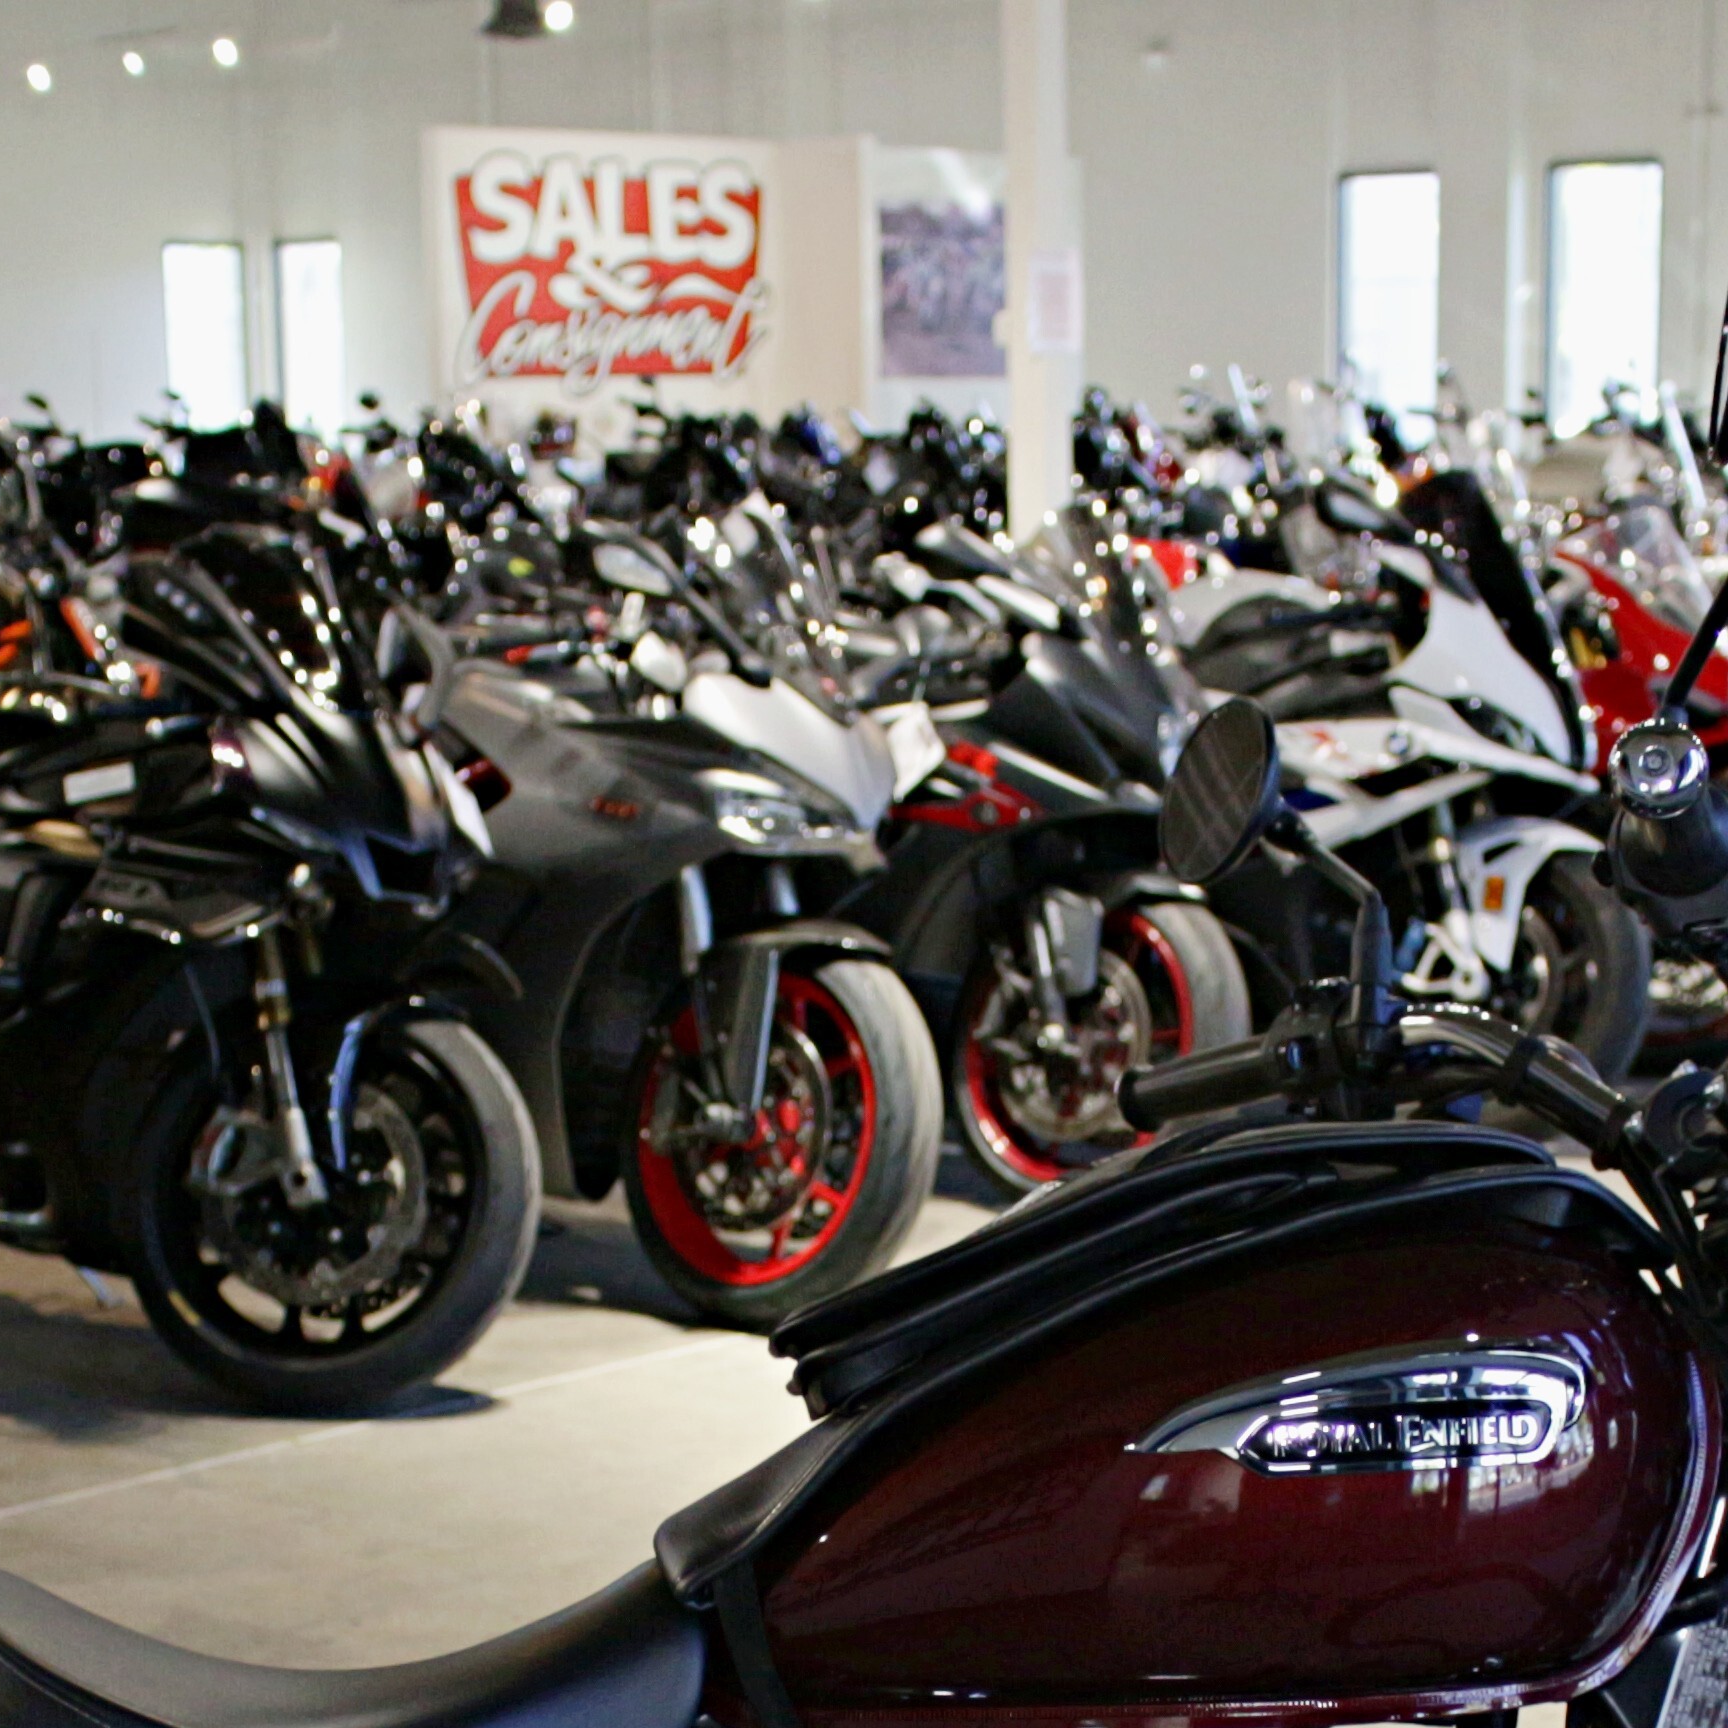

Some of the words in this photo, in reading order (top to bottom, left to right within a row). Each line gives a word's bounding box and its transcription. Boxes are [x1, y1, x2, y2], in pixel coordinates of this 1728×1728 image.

[468, 150, 758, 269] SALES
[548, 249, 658, 312] &
[456, 270, 770, 395] Consignment
[1403, 1414, 1538, 1452] ENFIELD
